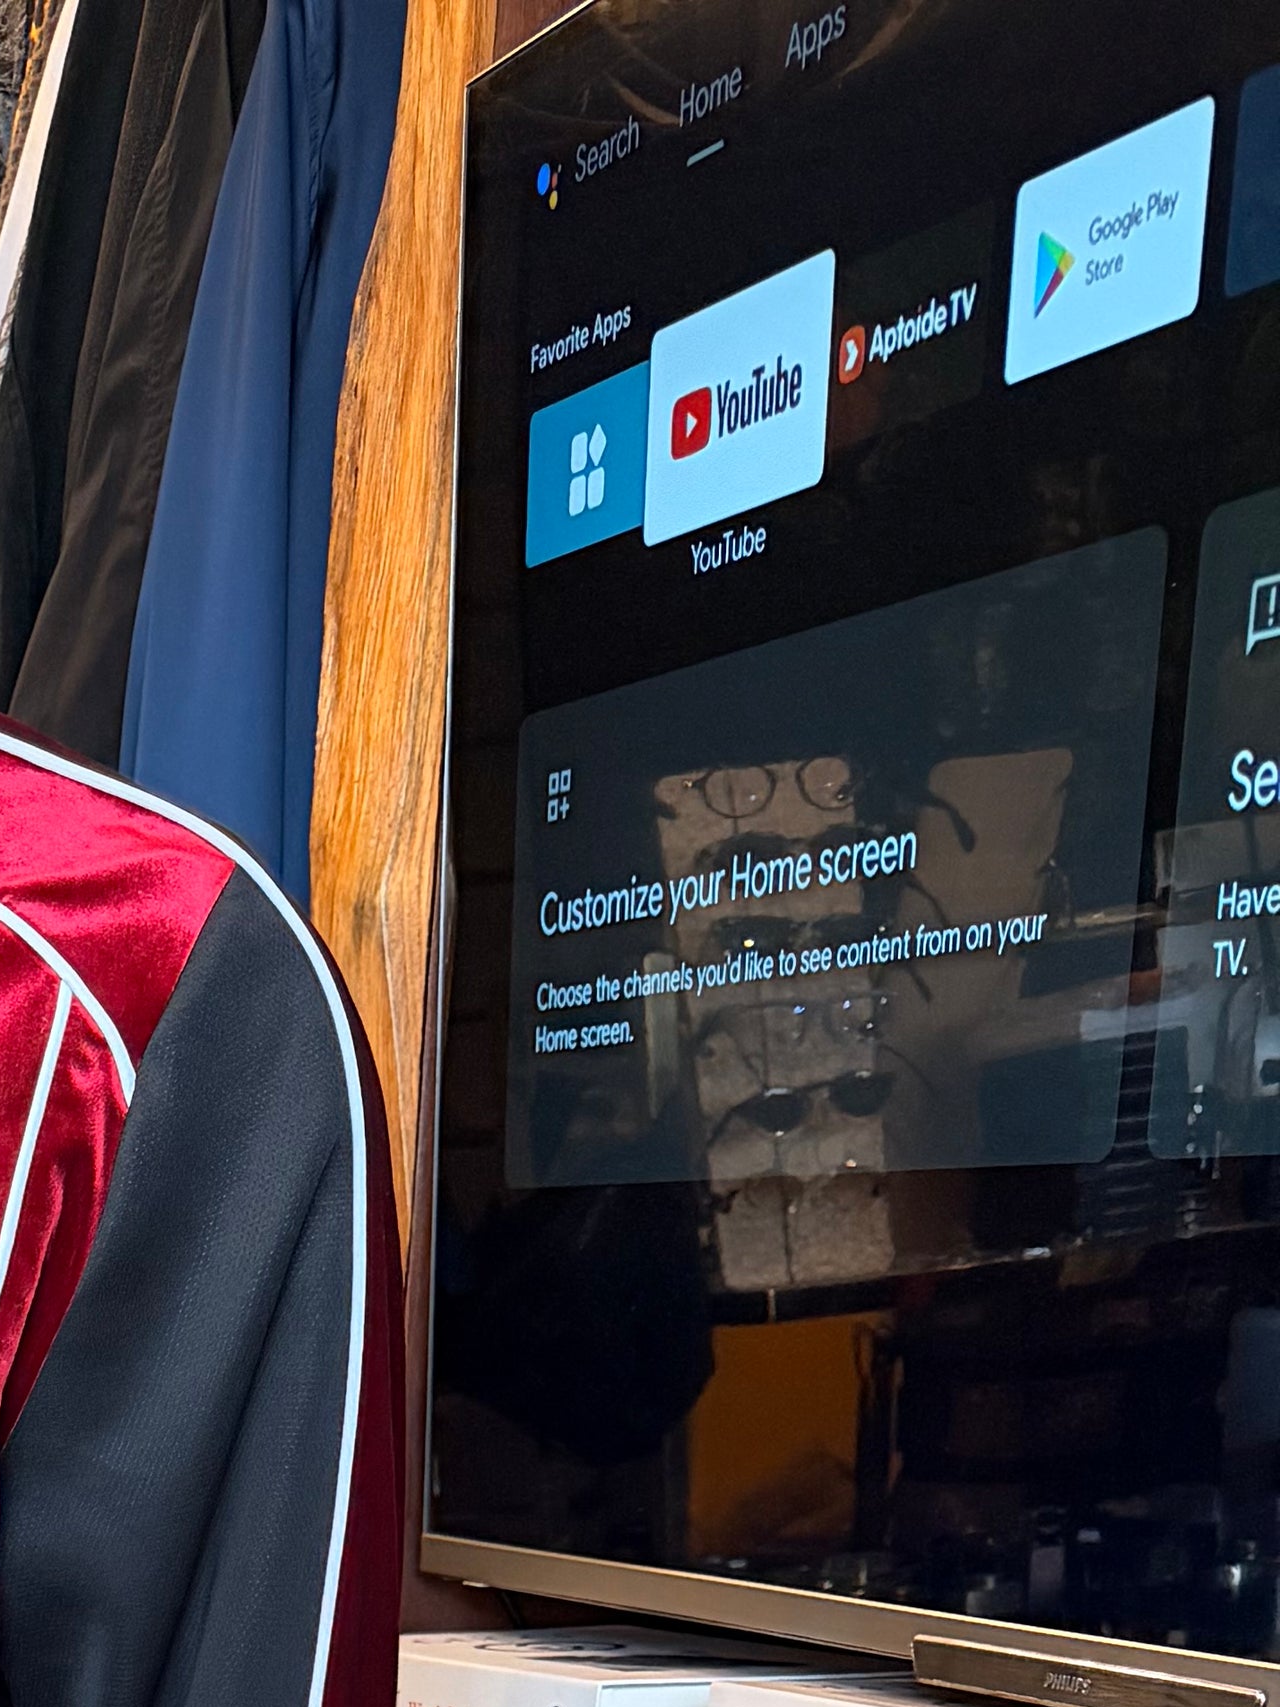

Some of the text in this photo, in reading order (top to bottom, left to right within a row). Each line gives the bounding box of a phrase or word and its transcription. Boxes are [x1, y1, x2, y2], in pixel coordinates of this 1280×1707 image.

[785, 5, 846, 70] Apps
[679, 67, 743, 128] Home
[575, 115, 640, 183] Search
[1089, 190, 1179, 246] Google Play
[1085, 254, 1124, 286] Store
[530, 305, 632, 374] Favorite Apps
[869, 282, 977, 363] Aptoide TV
[716, 353, 802, 438] YouTube
[690, 525, 767, 575] YouTube
[1228, 749, 1280, 812] Se
[540, 831, 917, 936] Customize your Home screen
[537, 913, 1048, 1011] Choose the channels you'd like to see content from on your
[1213, 938, 1248, 978] TV.
[535, 1020, 635, 1053] Home screen.
